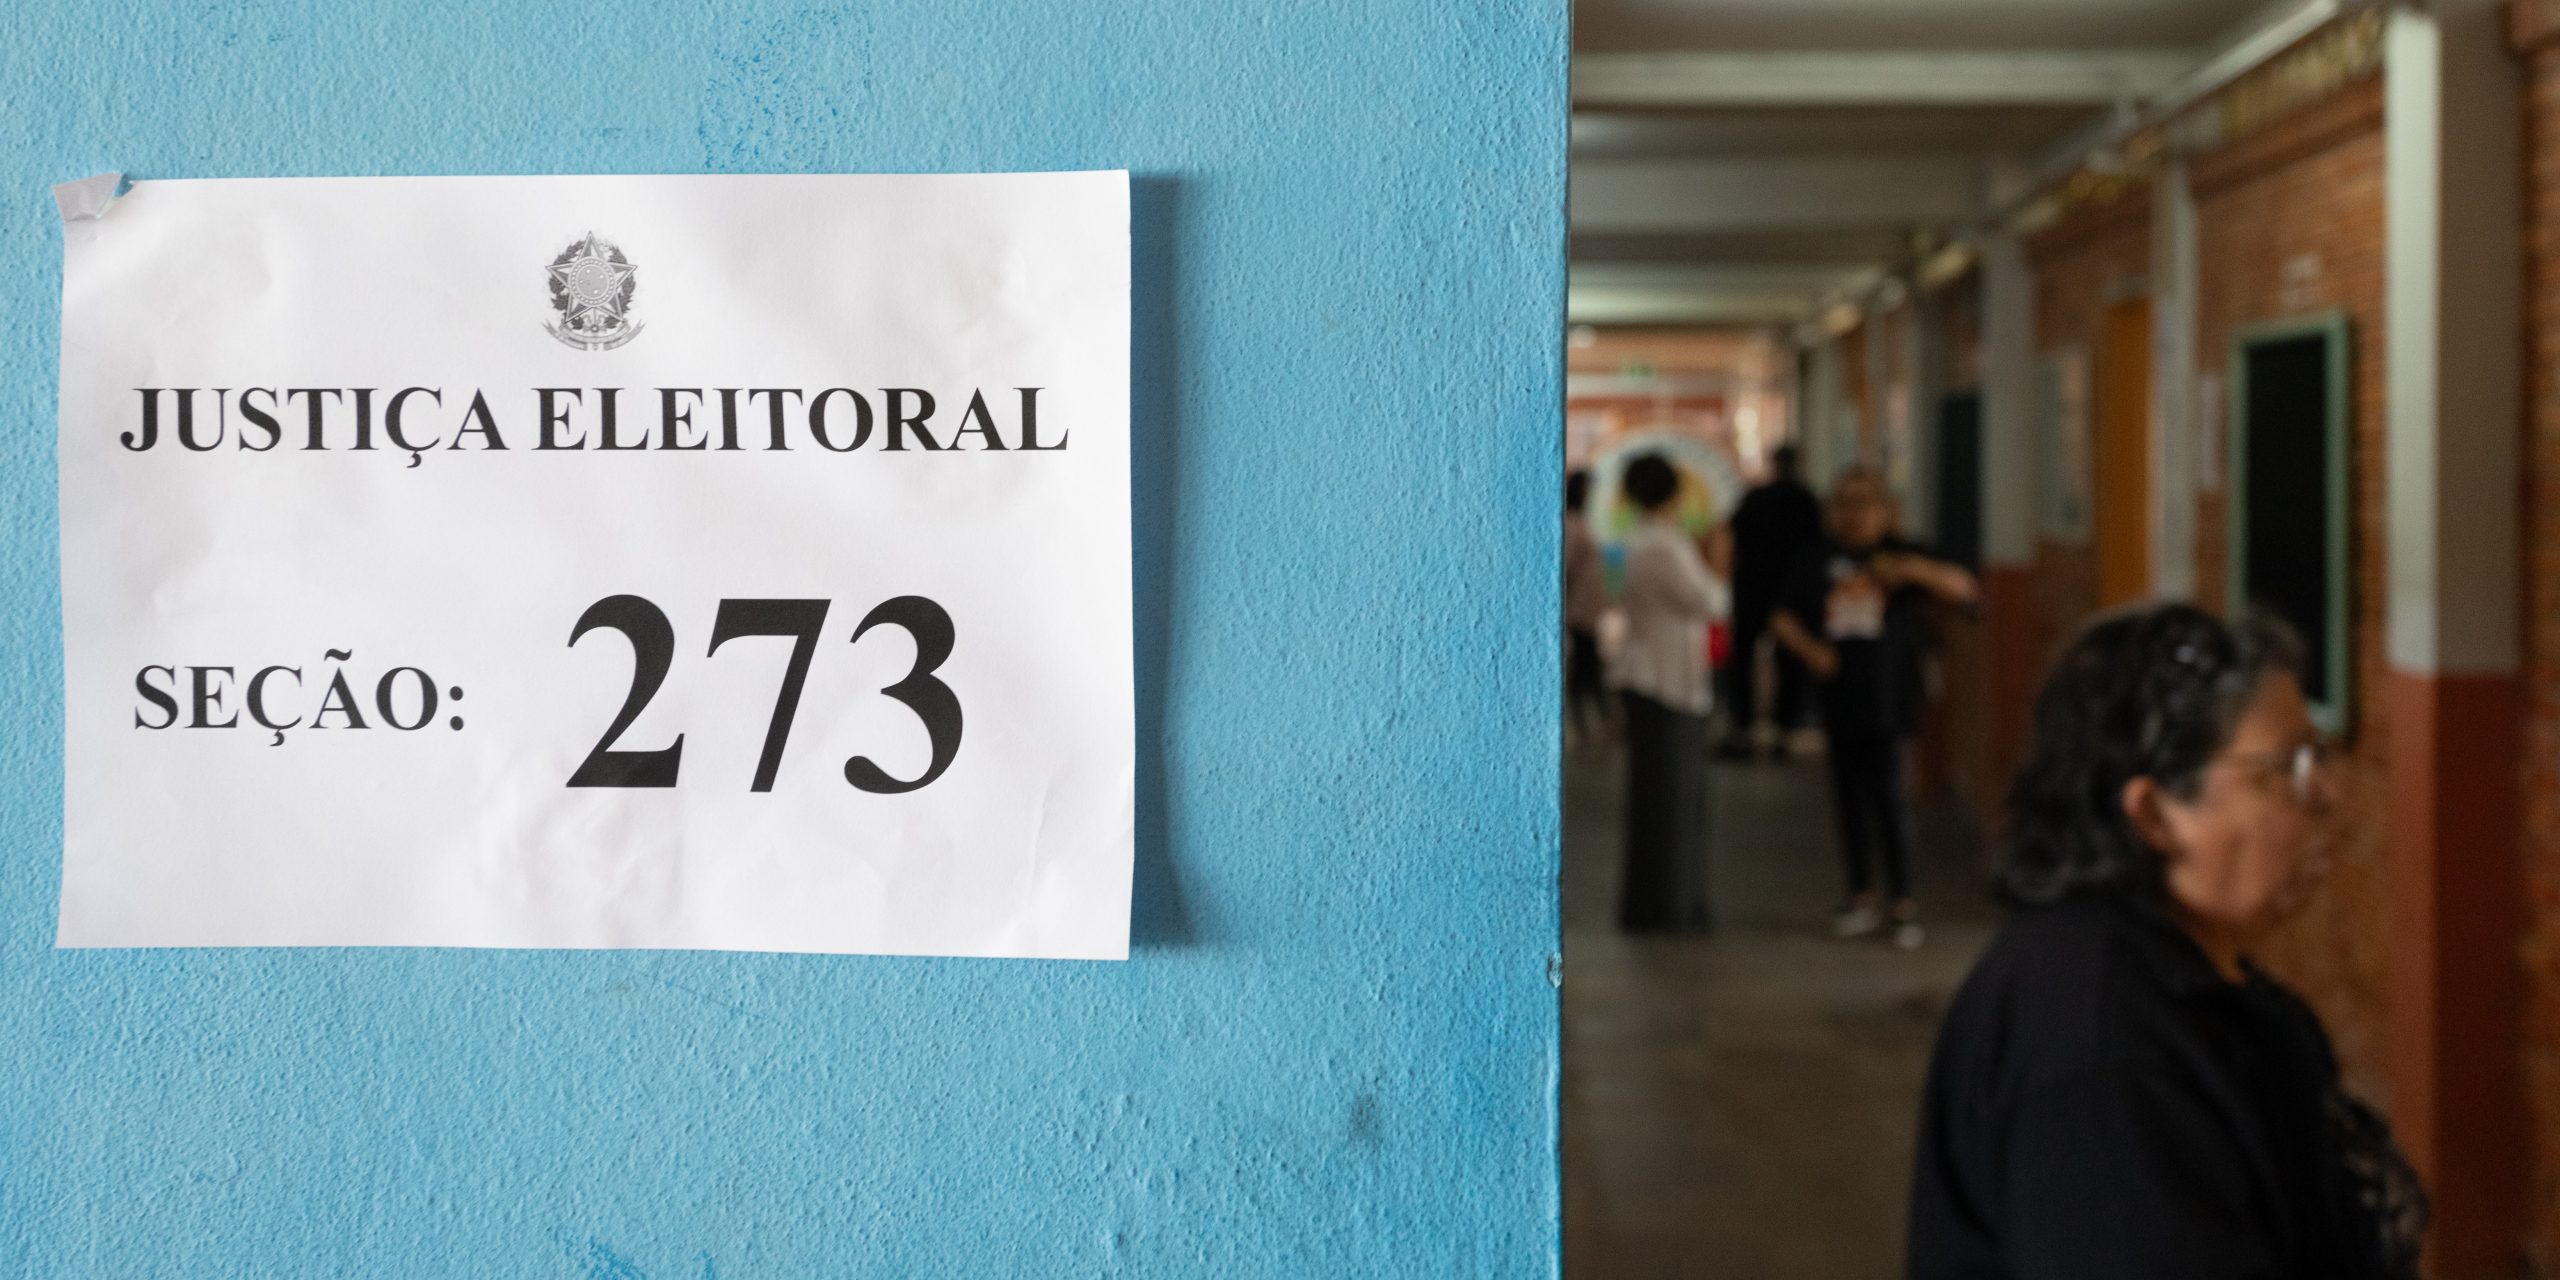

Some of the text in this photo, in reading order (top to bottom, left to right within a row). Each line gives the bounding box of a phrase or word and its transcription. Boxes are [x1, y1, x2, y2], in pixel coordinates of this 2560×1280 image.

[120, 387, 1069, 468] JUSTIÇA ELEITORAL
[133, 593, 964, 795] SEÇÃO: 273
